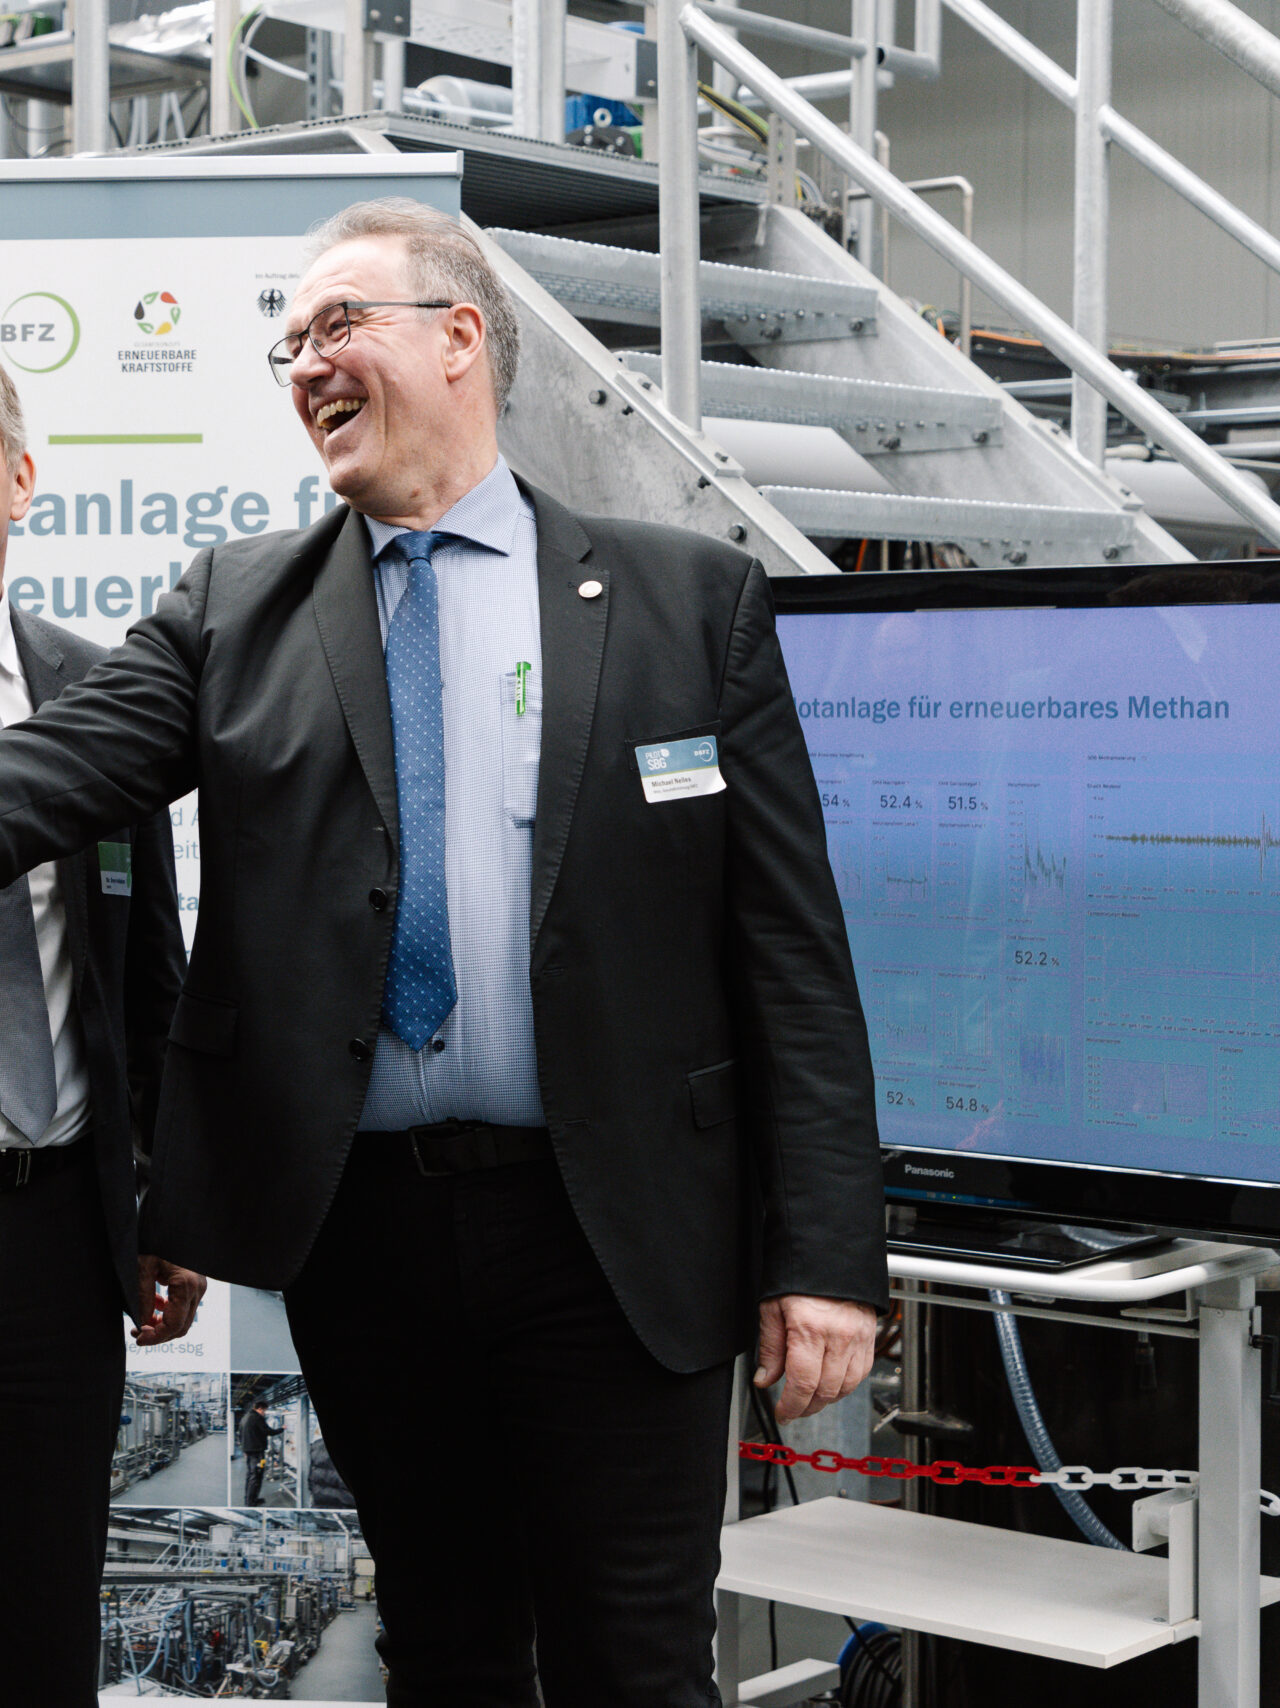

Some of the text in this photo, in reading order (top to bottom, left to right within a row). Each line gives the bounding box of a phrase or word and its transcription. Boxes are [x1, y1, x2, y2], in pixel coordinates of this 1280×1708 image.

[118, 349, 197, 361] ERNEUERBARE
[121, 362, 193, 373] KRAFTSTOFFE
[907, 695, 942, 719] für
[949, 695, 1119, 719] erneuerbares
[1127, 695, 1230, 719] Methan
[647, 758, 668, 771] SBG
[822, 794, 839, 807] 54
[880, 795, 911, 809] 52.4
[948, 796, 978, 810] 51.5
[1014, 950, 1048, 966] 52.2
[886, 1091, 904, 1105] 52
[945, 1096, 978, 1112] 54.8
[904, 1163, 955, 1179] Panasonic
